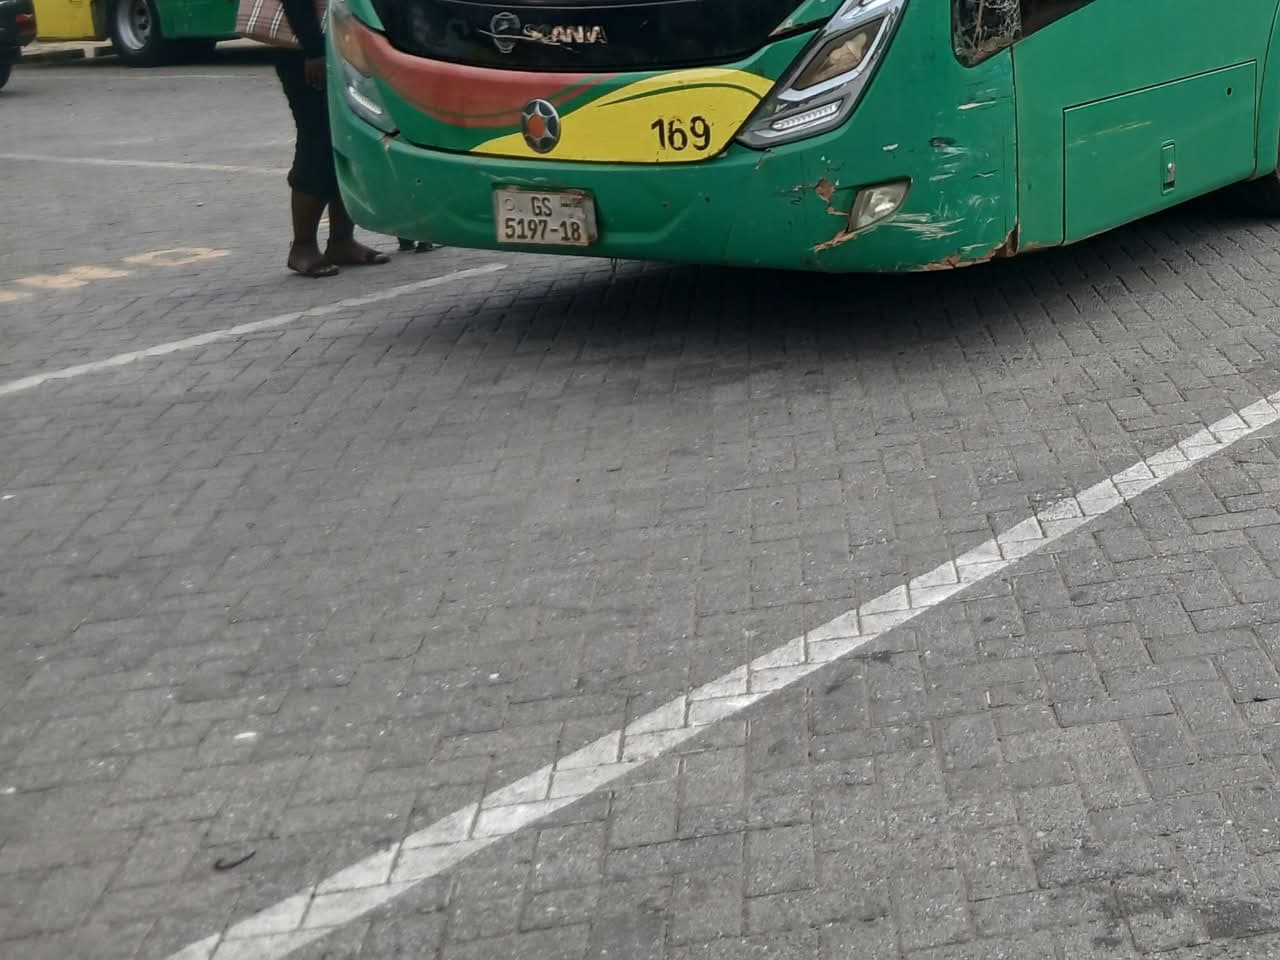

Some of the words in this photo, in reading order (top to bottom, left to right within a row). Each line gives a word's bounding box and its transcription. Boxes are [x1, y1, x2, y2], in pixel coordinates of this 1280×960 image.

[651, 116, 710, 151] 169
[531, 196, 553, 217] GS
[505, 218, 582, 241] 5197-18
